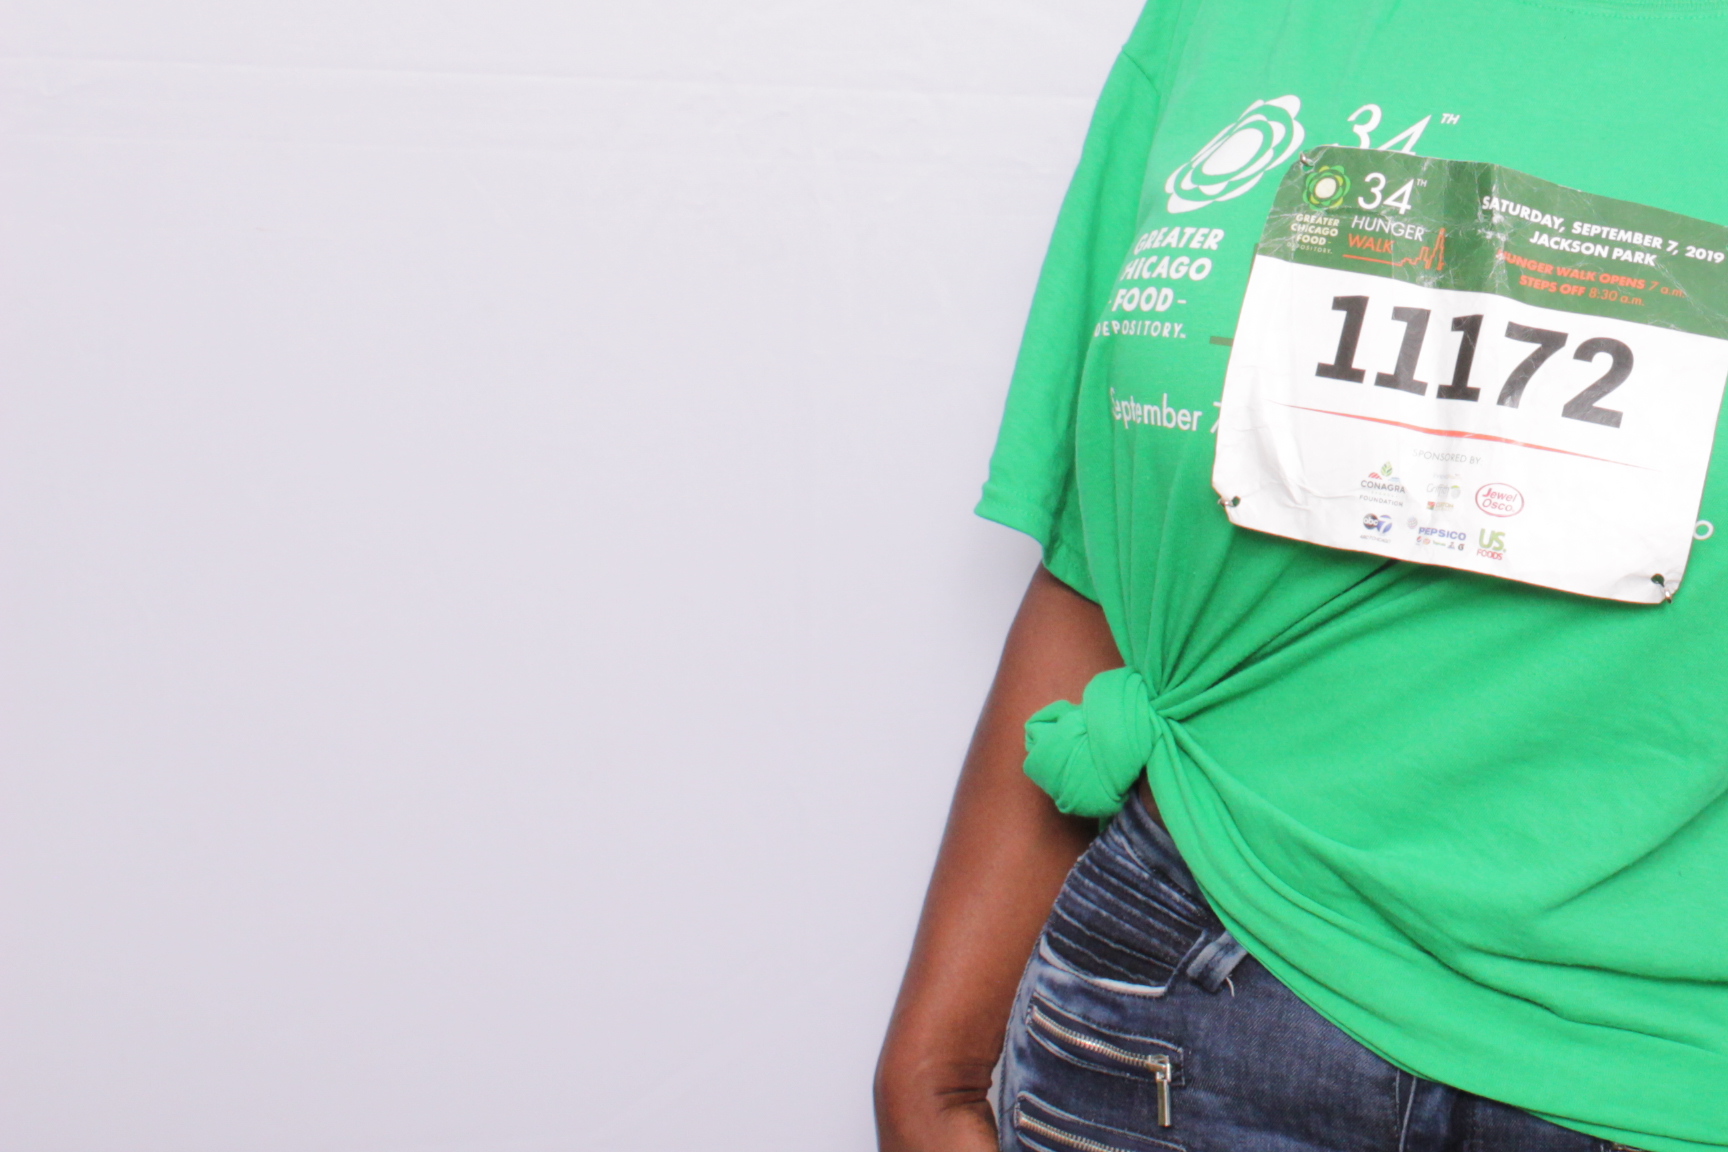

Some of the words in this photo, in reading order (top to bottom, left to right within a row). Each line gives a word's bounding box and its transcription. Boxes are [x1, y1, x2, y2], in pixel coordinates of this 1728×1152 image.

[1290, 223, 1339, 237] CHICAGO
[1295, 213, 1340, 227] GREATER
[1351, 215, 1425, 242] HUNGER
[1481, 195, 1566, 232] SATURDAY,
[1571, 221, 1664, 250] SEPTEMBER
[1666, 239, 1680, 255] 7,
[1684, 245, 1726, 264] 2019
[1133, 226, 1225, 256] GREATER
[1296, 232, 1327, 245] FOOD
[1348, 233, 1396, 254] WALK
[1529, 231, 1610, 259] JACKSON
[1611, 247, 1658, 267] PARK
[1119, 255, 1213, 281] HICAGO
[1556, 266, 1597, 282] WALK
[1599, 273, 1647, 290] OPENS
[1649, 281, 1660, 291] 7
[1519, 275, 1557, 293] STEPS
[1559, 283, 1587, 296] OFF
[1588, 287, 1618, 302] 8:30
[1314, 294, 1635, 430] 11172
[1360, 479, 1406, 494] CONAGRA
[1482, 487, 1518, 502] Jewel
[1359, 494, 1404, 508] FOUNDATION
[1418, 526, 1467, 541] PEPSICO
[1476, 549, 1503, 561] FOODS
